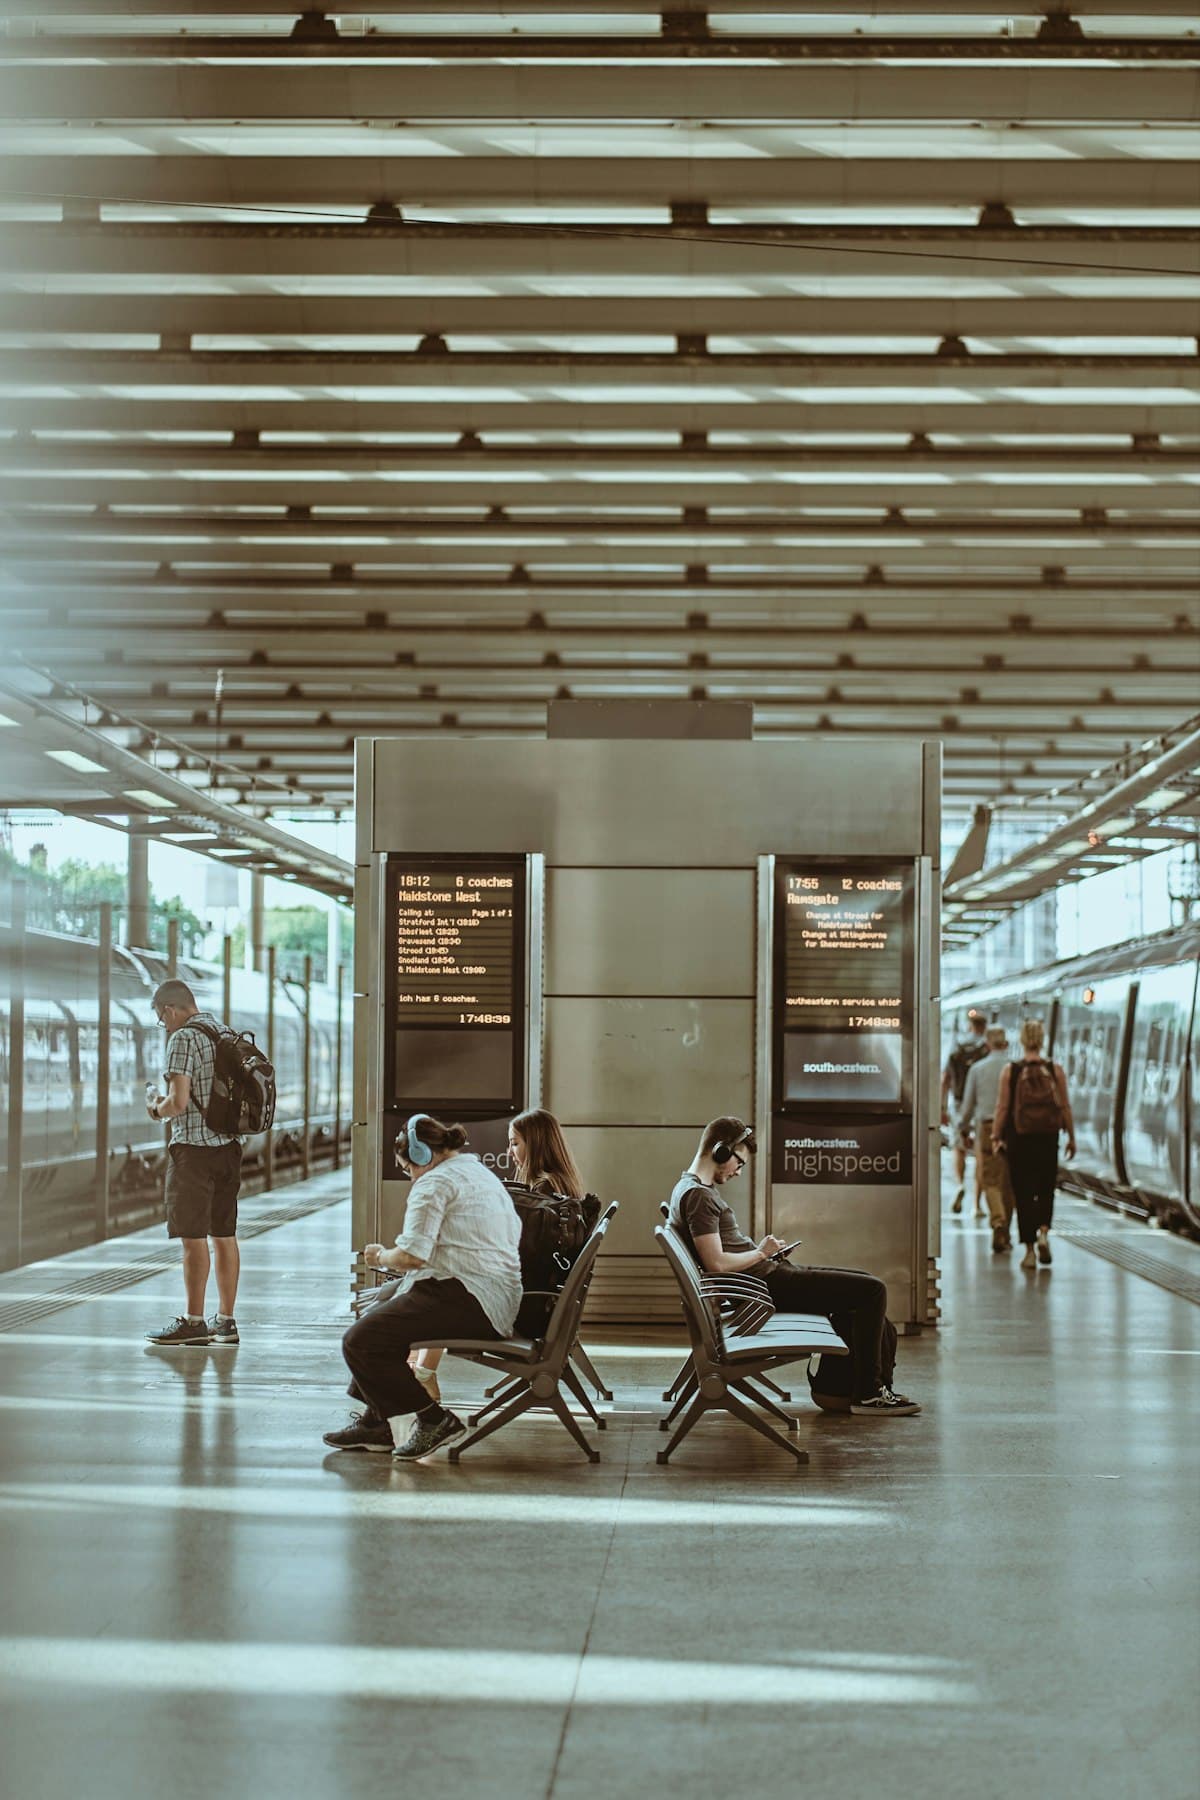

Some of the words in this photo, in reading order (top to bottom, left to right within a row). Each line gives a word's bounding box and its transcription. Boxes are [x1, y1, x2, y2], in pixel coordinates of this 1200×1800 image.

[400, 875, 430, 887] 18:12
[455, 875, 464, 887] 6
[468, 876, 513, 888] coaches
[789, 877, 819, 889] 17:55
[841, 878, 853, 890] 12
[856, 879, 902, 891] coaches
[398, 890, 452, 902] Maidstone
[455, 891, 481, 902] West
[787, 893, 839, 906] Ramsgate
[398, 908, 422, 918] Calling
[472, 909, 489, 918] Page
[490, 909, 495, 917] 1
[497, 909, 506, 917] of
[508, 909, 513, 917] 1
[398, 918, 435, 926] Stratford
[398, 927, 433, 936] Ebbsfleet
[801, 930, 827, 940] Change
[829, 930, 838, 938] at
[398, 937, 436, 945] Gravesend
[398, 946, 423, 954] Strood
[397, 956, 430, 964] Snodland
[405, 966, 441, 974] Maidstone
[442, 966, 461, 974] West
[415, 994, 431, 1002] has
[433, 994, 440, 1002] 6
[442, 994, 479, 1003] coaches.
[842, 997, 876, 1006] service
[460, 1014, 511, 1024] 17:48:39
[784, 1149, 900, 1178] highspeed
